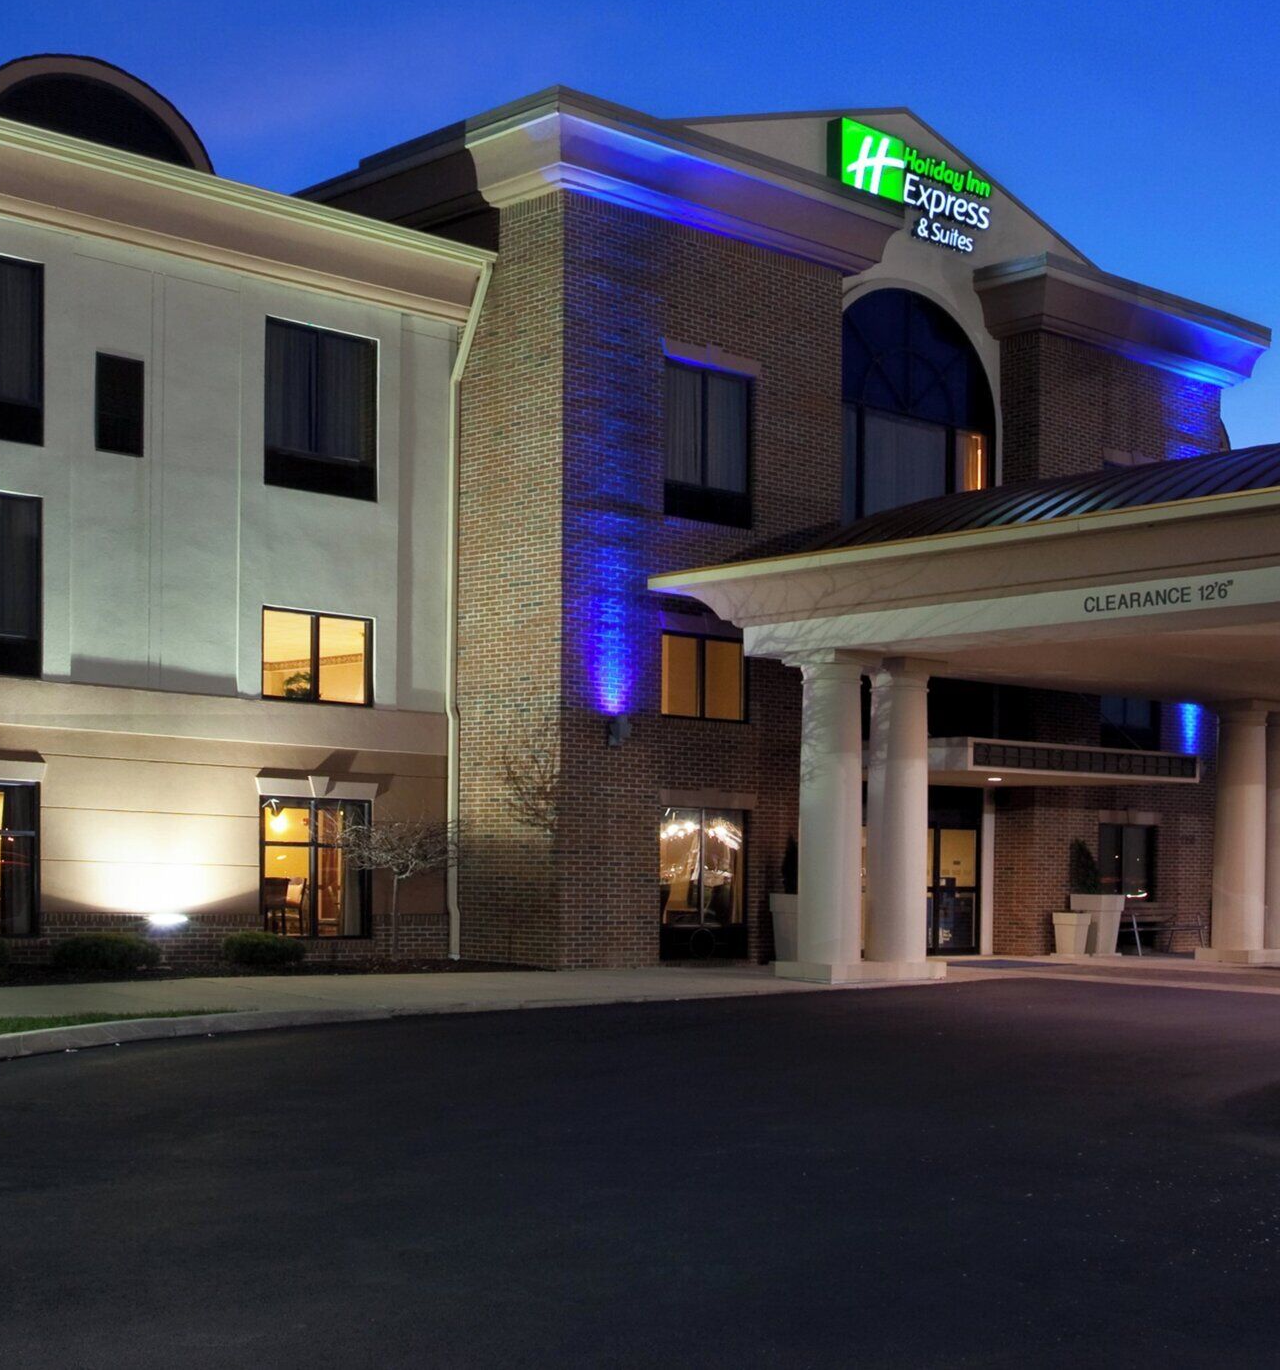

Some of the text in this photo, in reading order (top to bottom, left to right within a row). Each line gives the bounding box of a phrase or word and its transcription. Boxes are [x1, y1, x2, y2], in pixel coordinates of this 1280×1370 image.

[904, 147, 991, 198] Holiday Inn
[903, 173, 990, 229] Express
[917, 218, 973, 252] & Suites
[1084, 586, 1191, 613] CLEARANCE
